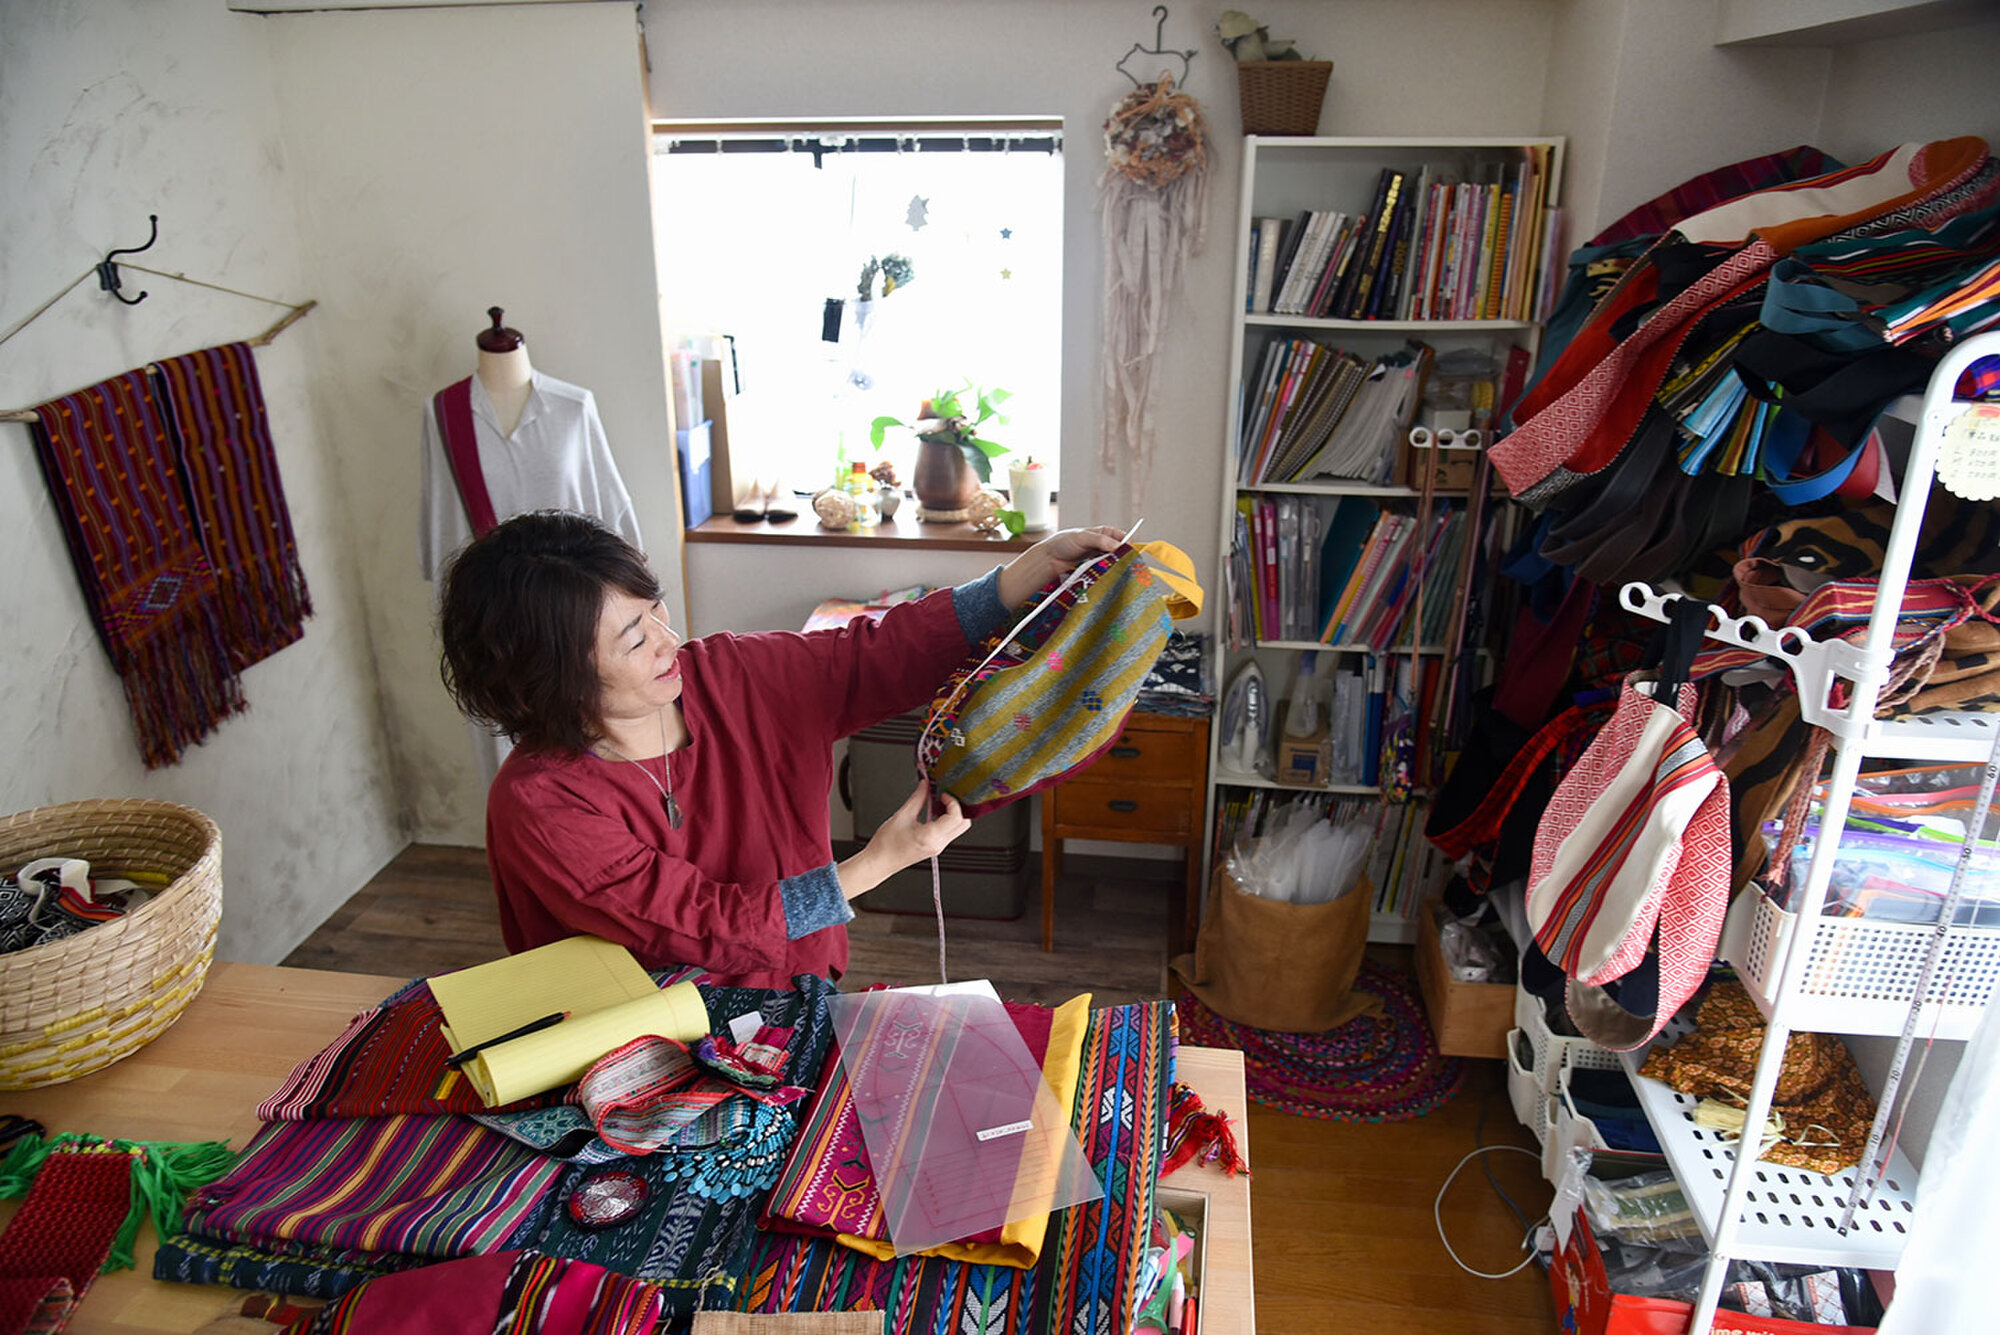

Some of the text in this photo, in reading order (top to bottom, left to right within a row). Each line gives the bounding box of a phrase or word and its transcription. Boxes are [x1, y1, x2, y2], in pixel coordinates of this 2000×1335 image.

[1987, 765, 1998, 779] 60
[1962, 847, 1973, 860] 50
[1937, 926, 1947, 939] 40
